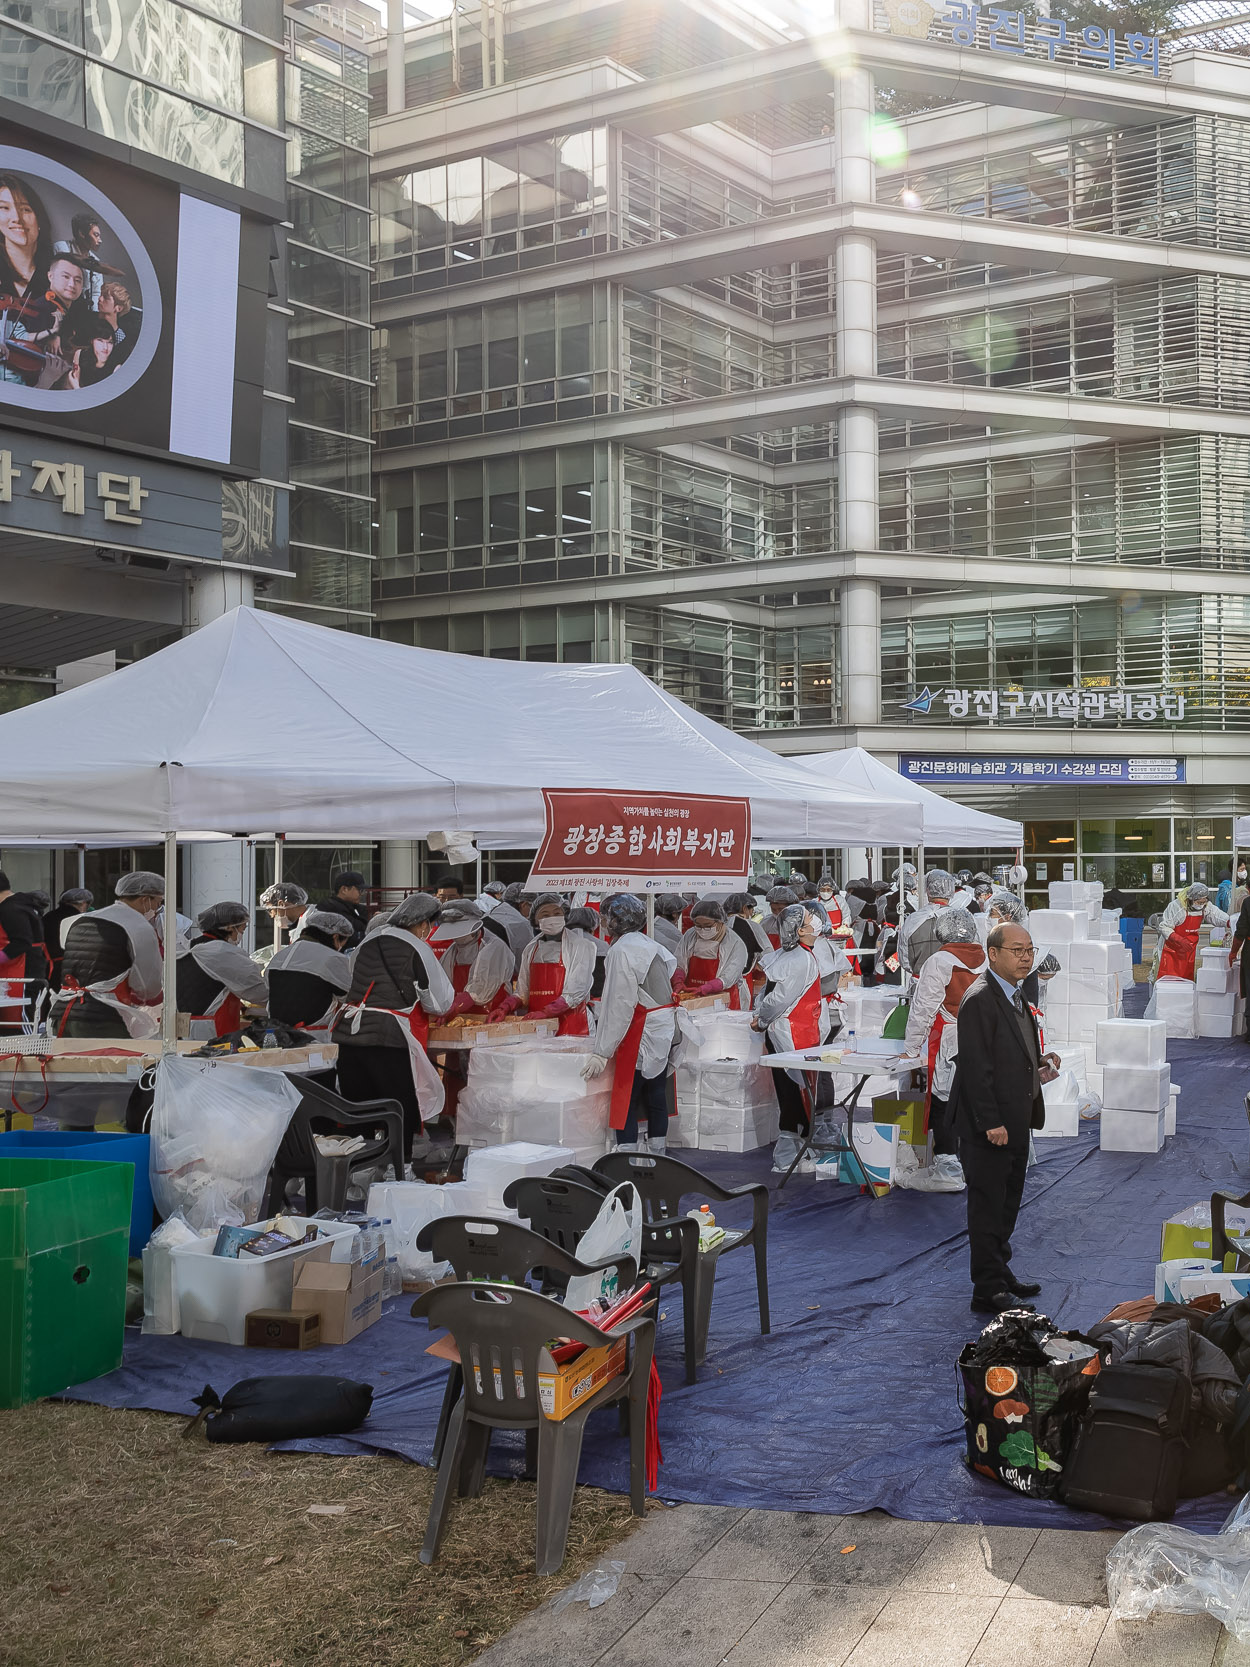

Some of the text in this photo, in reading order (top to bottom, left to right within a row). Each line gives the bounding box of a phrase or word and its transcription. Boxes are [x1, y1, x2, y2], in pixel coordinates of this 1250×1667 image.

[942, 1, 1160, 77] 광진구의회
[943, 689, 1188, 721] 광진구시설관리공단
[908, 761, 1122, 776] 광진문화예술회관 겨울학기 수강생 모집
[545, 879, 559, 887] 2023
[586, 878, 604, 887] 사랑의
[605, 878, 630, 887] 김장축제
